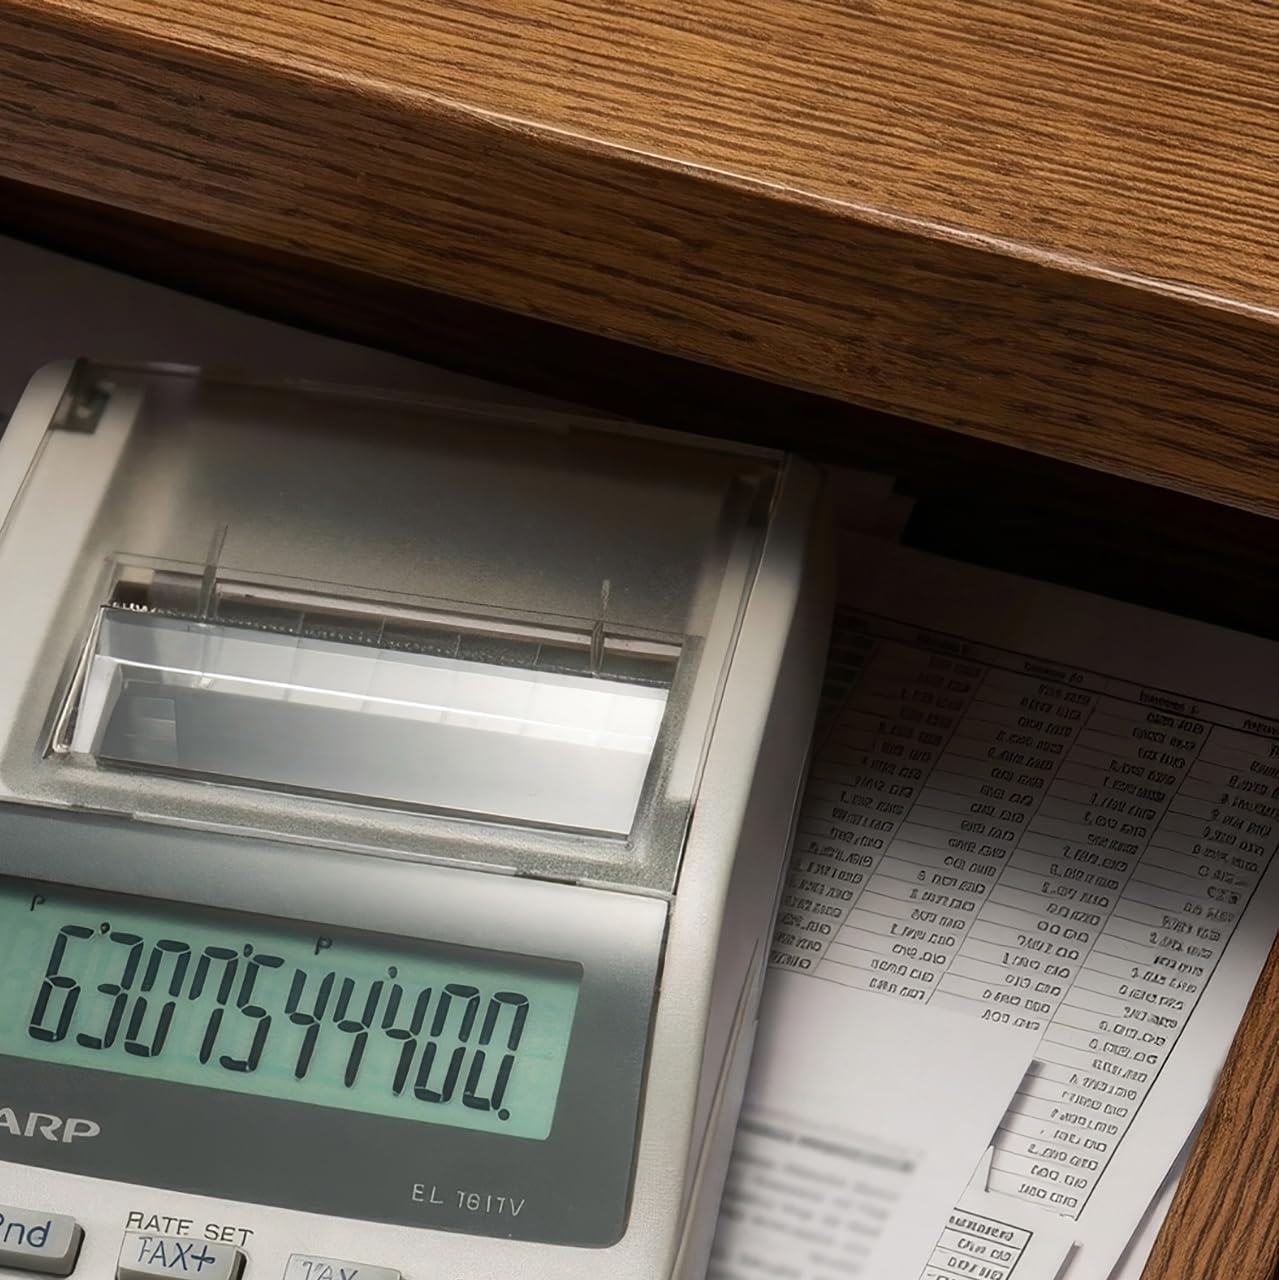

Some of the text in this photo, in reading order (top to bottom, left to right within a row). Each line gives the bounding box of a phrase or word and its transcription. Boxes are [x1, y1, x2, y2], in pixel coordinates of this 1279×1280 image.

[412, 1184, 444, 1204] EL
[125, 1211, 254, 1247] RATE SET
